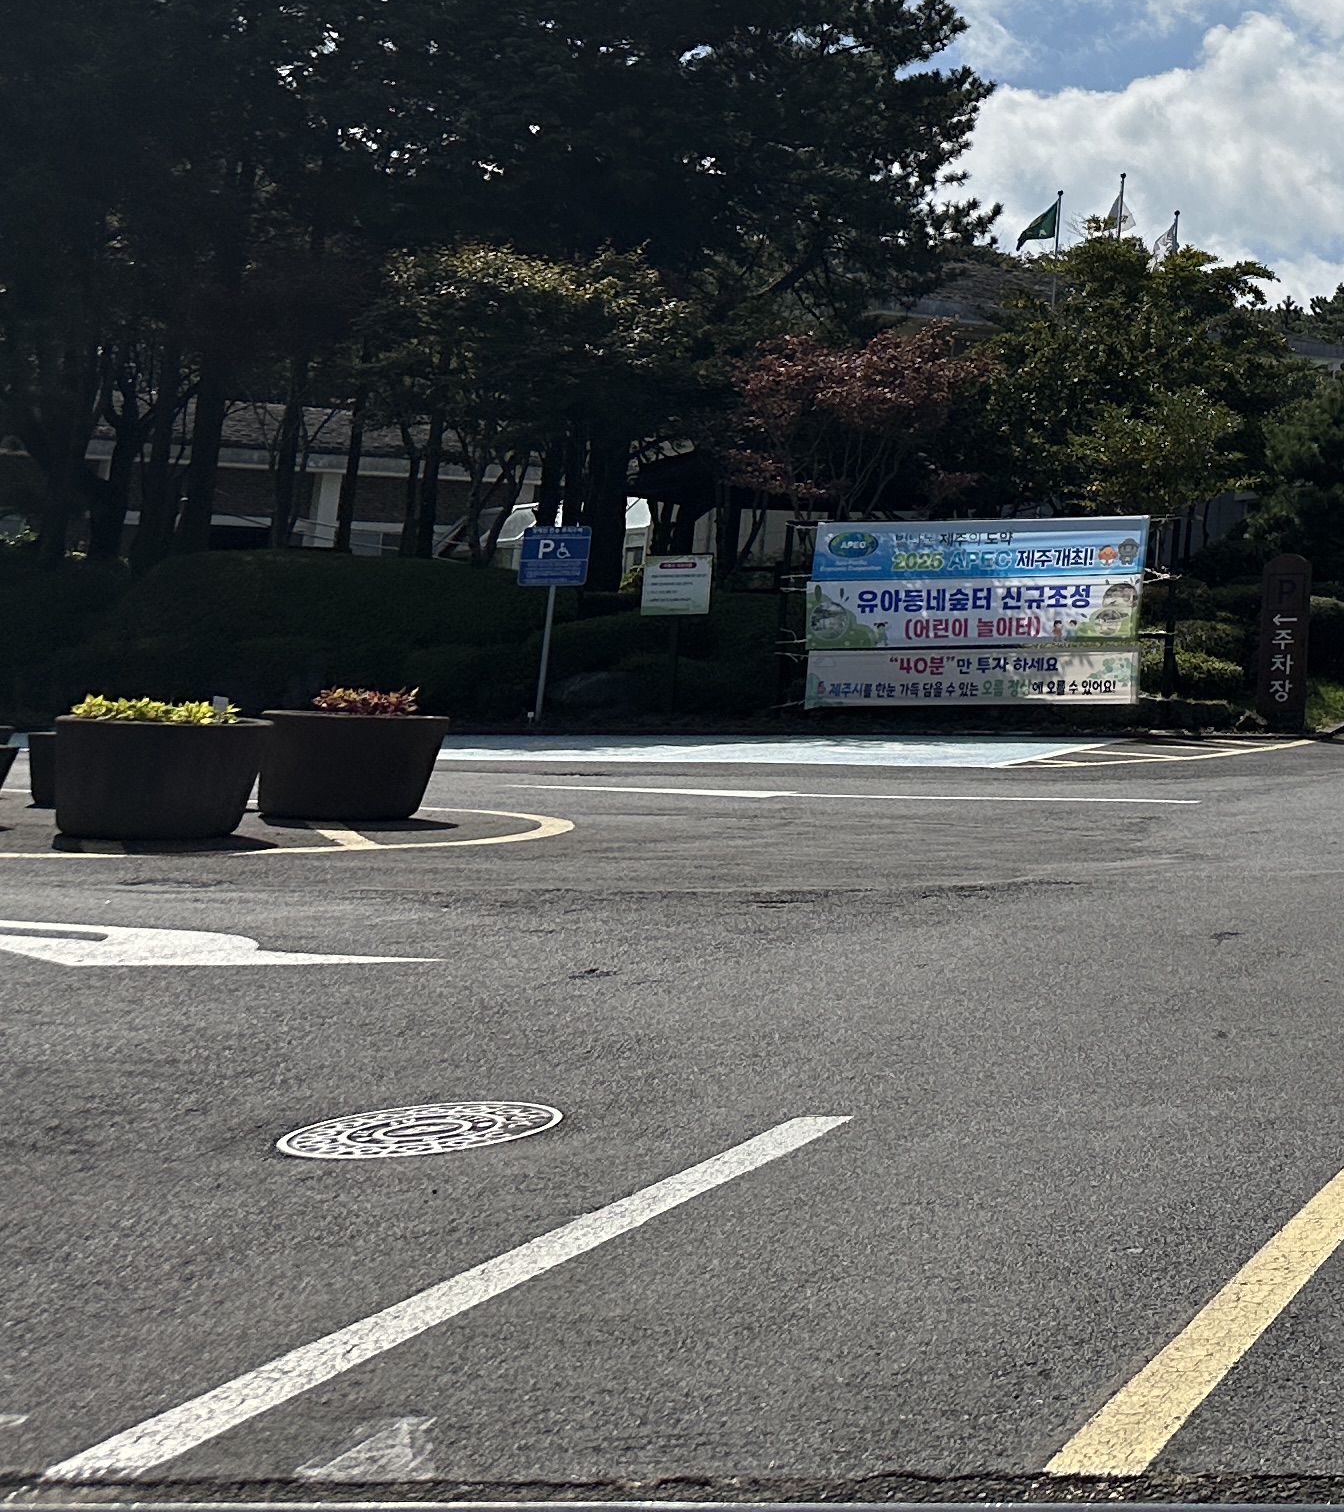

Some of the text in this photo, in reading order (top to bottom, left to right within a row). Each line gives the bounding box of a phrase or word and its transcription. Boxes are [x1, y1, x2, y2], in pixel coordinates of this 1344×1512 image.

[538, 539, 555, 559] P
[840, 540, 867, 550] APEC
[939, 532, 980, 547] 제주의
[985, 531, 1014, 546] 도약
[892, 550, 945, 572] 2025
[948, 550, 1012, 571] APEC
[857, 585, 1092, 614] 유아동네숲터 신규조성
[1278, 579, 1297, 604] P
[904, 615, 1041, 640] (어린이 놀이터)
[976, 656, 1009, 674] 투자
[1013, 656, 1059, 673] 하세요
[1269, 629, 1295, 703] 주차장
[828, 682, 873, 699] 제주시를
[876, 681, 896, 698] 한눈
[900, 681, 920, 698] 가득
[945, 681, 956, 696] 수
[959, 680, 979, 697] 있는
[1068, 679, 1079, 695] 수
[1081, 679, 1117, 696] 있어요!
